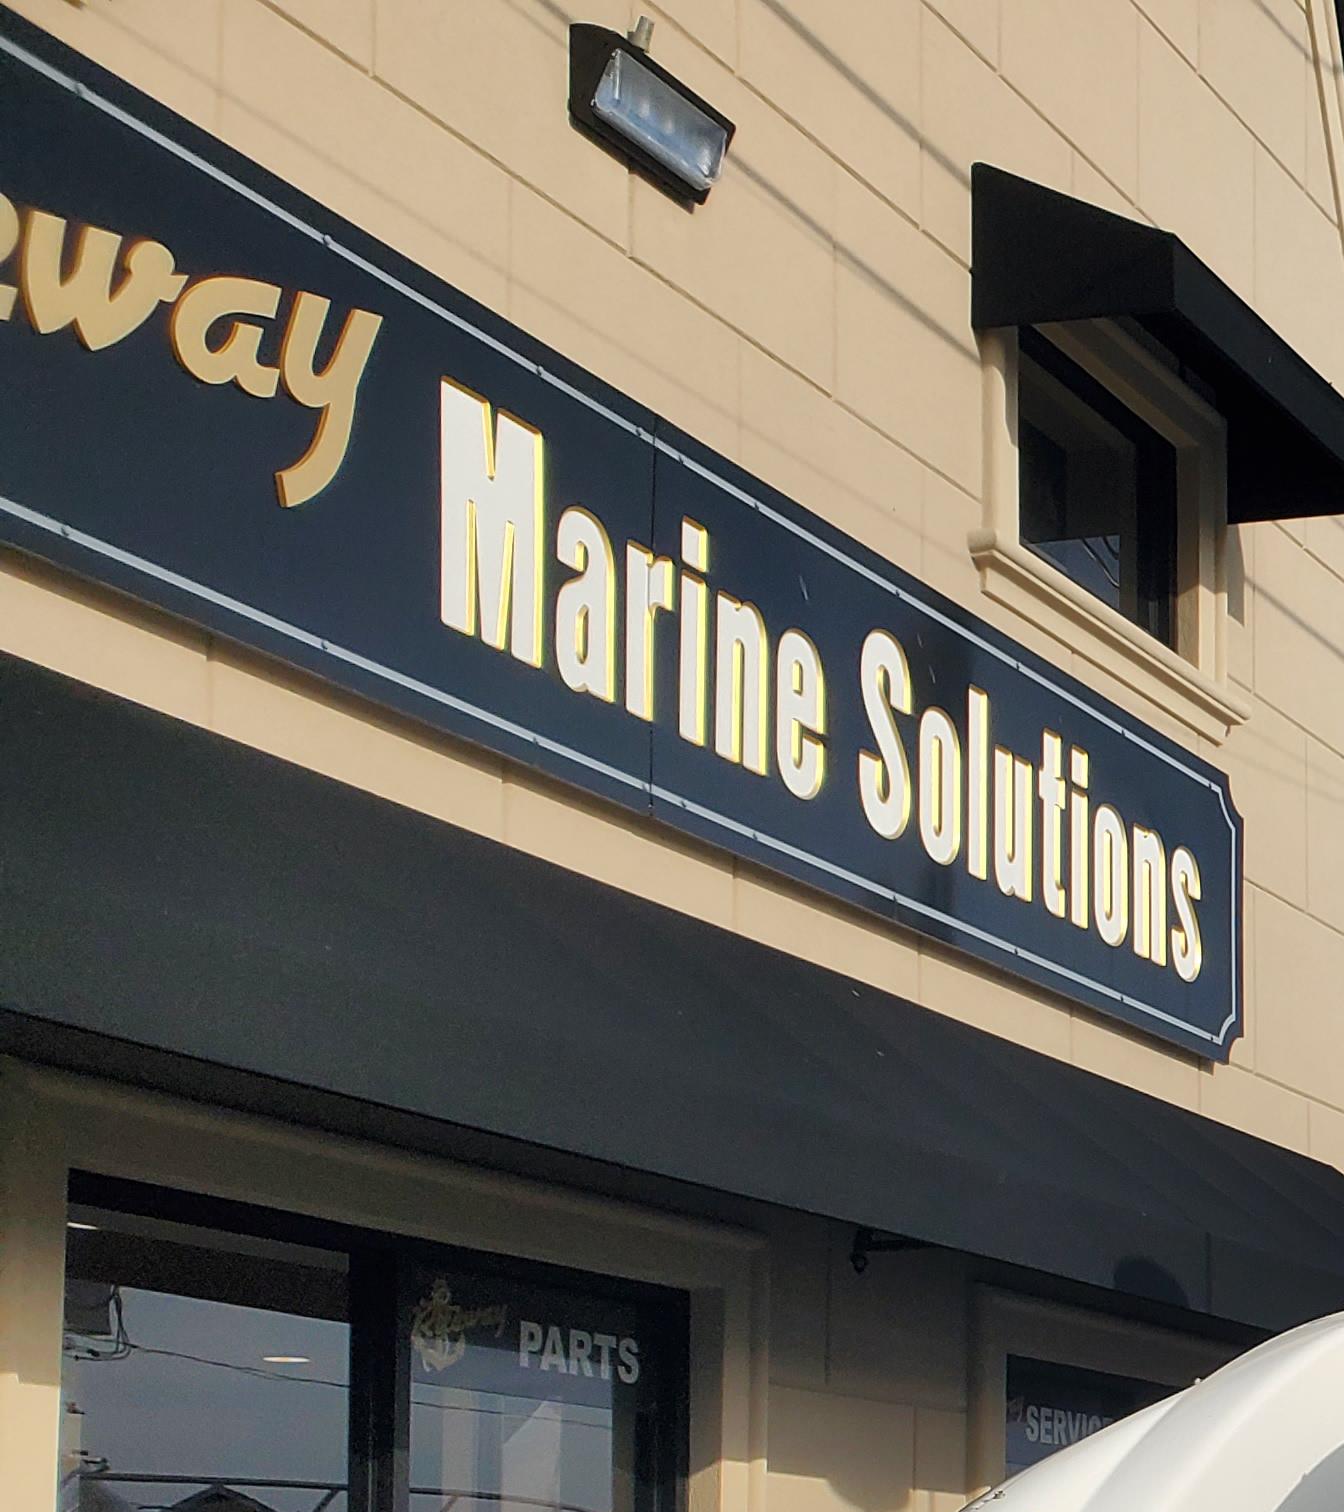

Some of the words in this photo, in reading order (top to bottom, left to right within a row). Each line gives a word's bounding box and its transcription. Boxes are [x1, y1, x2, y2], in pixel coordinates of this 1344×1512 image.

[0, 192, 384, 508] way
[440, 375, 826, 800] Marine
[858, 628, 1202, 982] Solutions
[519, 1319, 640, 1385] PARTS
[1025, 1404, 1113, 1446] SERVIC
